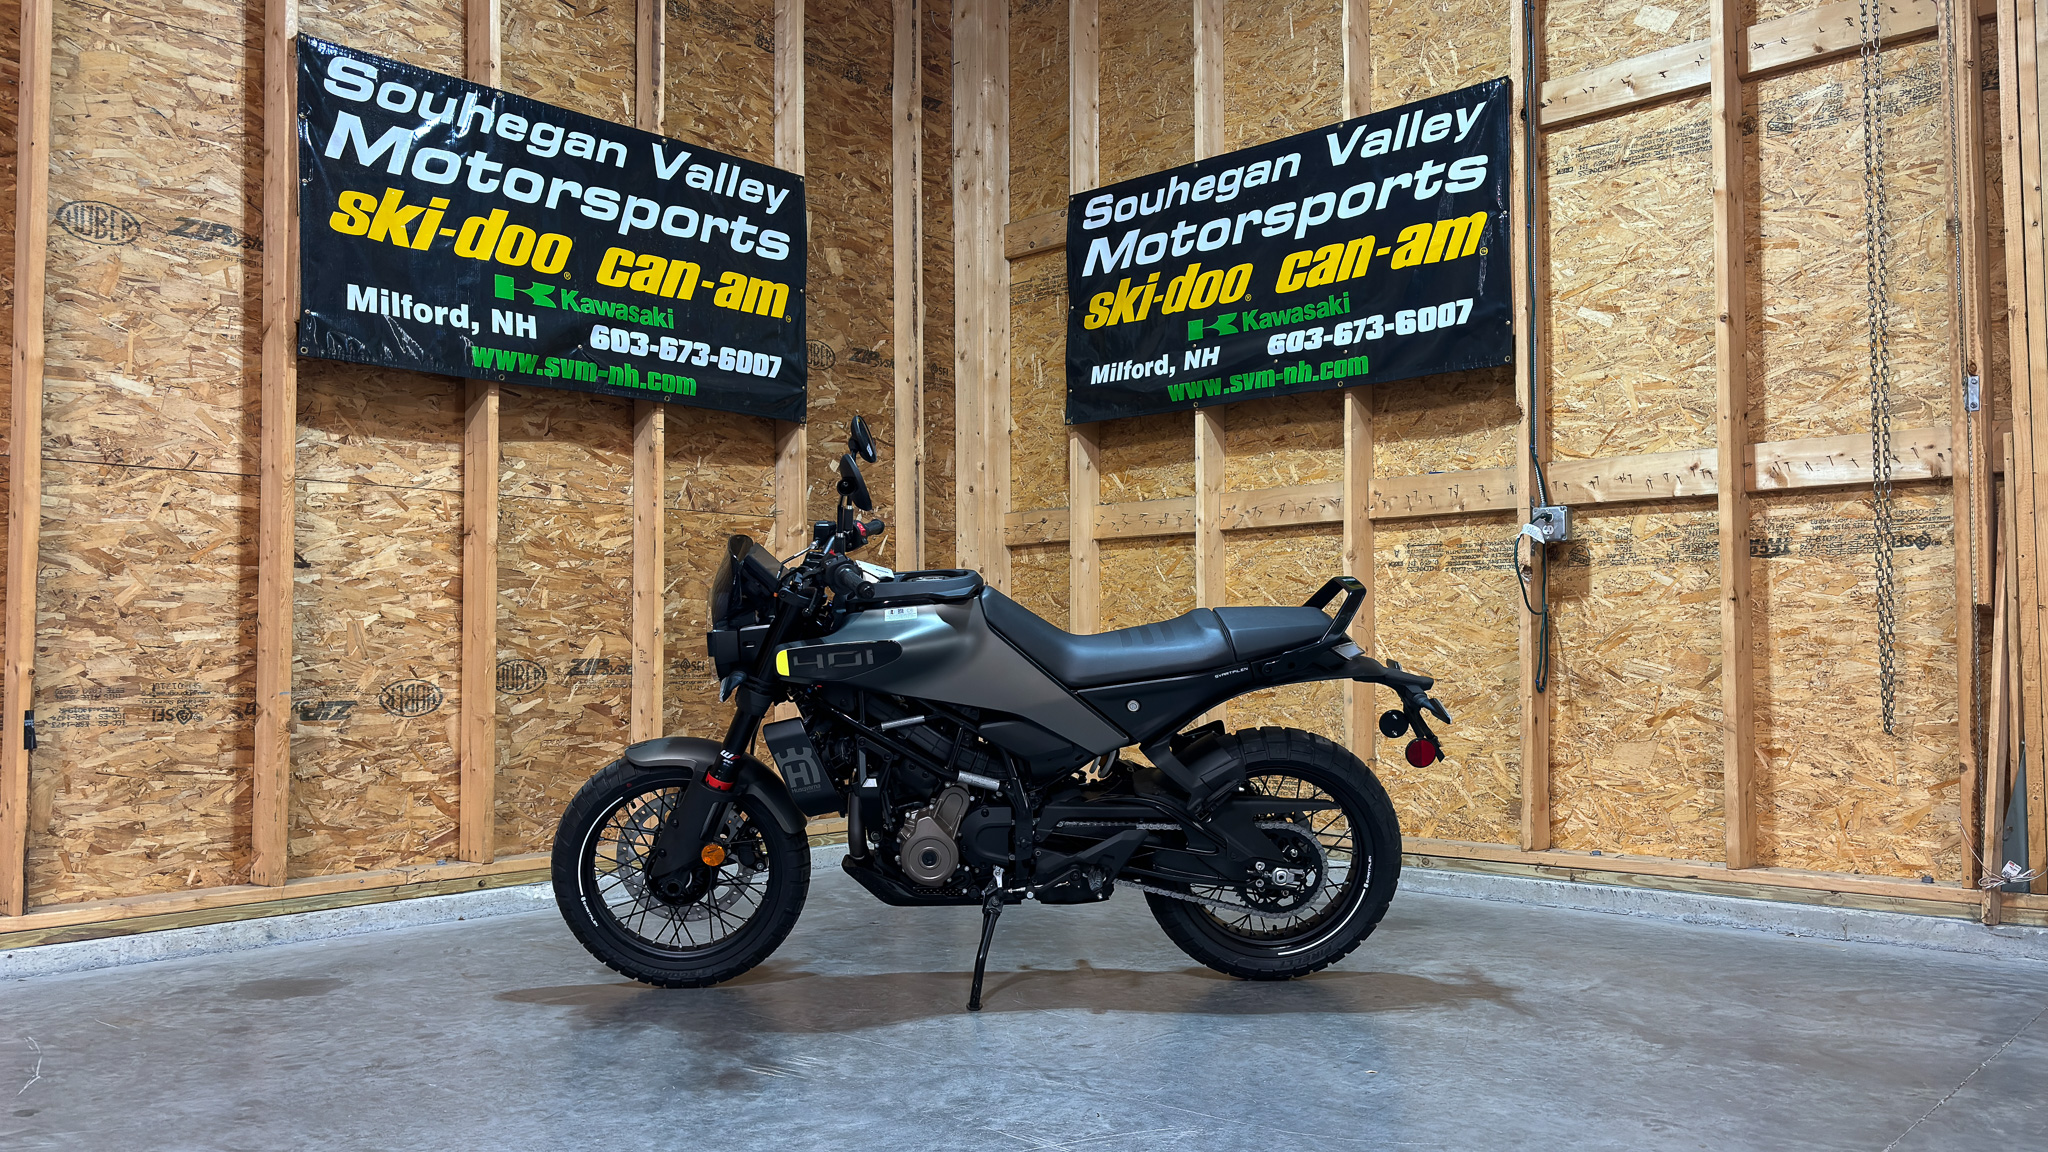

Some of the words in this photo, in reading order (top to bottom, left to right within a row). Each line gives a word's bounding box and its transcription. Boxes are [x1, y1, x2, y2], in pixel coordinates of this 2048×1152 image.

[324, 54, 627, 168] Souhegan
[652, 139, 790, 214] Valley
[324, 112, 790, 260] Motorsports
[1083, 150, 1301, 229] Souhegan
[1327, 101, 1487, 166] Valley
[66, 205, 133, 241] HUBER
[1082, 150, 1488, 276] Motorsports
[330, 188, 572, 274] ski-doo
[597, 247, 790, 318] can-am
[1084, 263, 1253, 330] ski-doo
[1276, 212, 1487, 293] can-am
[347, 284, 479, 336] Milford,
[492, 308, 537, 339] NH
[561, 289, 675, 330] Kawasaki
[1242, 292, 1350, 332] Kawasaki
[1268, 298, 1474, 355] 603-673-6007
[472, 345, 697, 396] www.svm-nh.com
[590, 325, 782, 379] 603-673-6007
[807, 341, 832, 367] UBER
[1090, 354, 1175, 384] Milford,
[1184, 346, 1221, 370] NH
[1168, 355, 1369, 401] www.svm-nh.com
[497, 664, 543, 691] HUBER
[152, 709, 175, 722] SFI
[792, 784, 820, 793] Husqvarna
